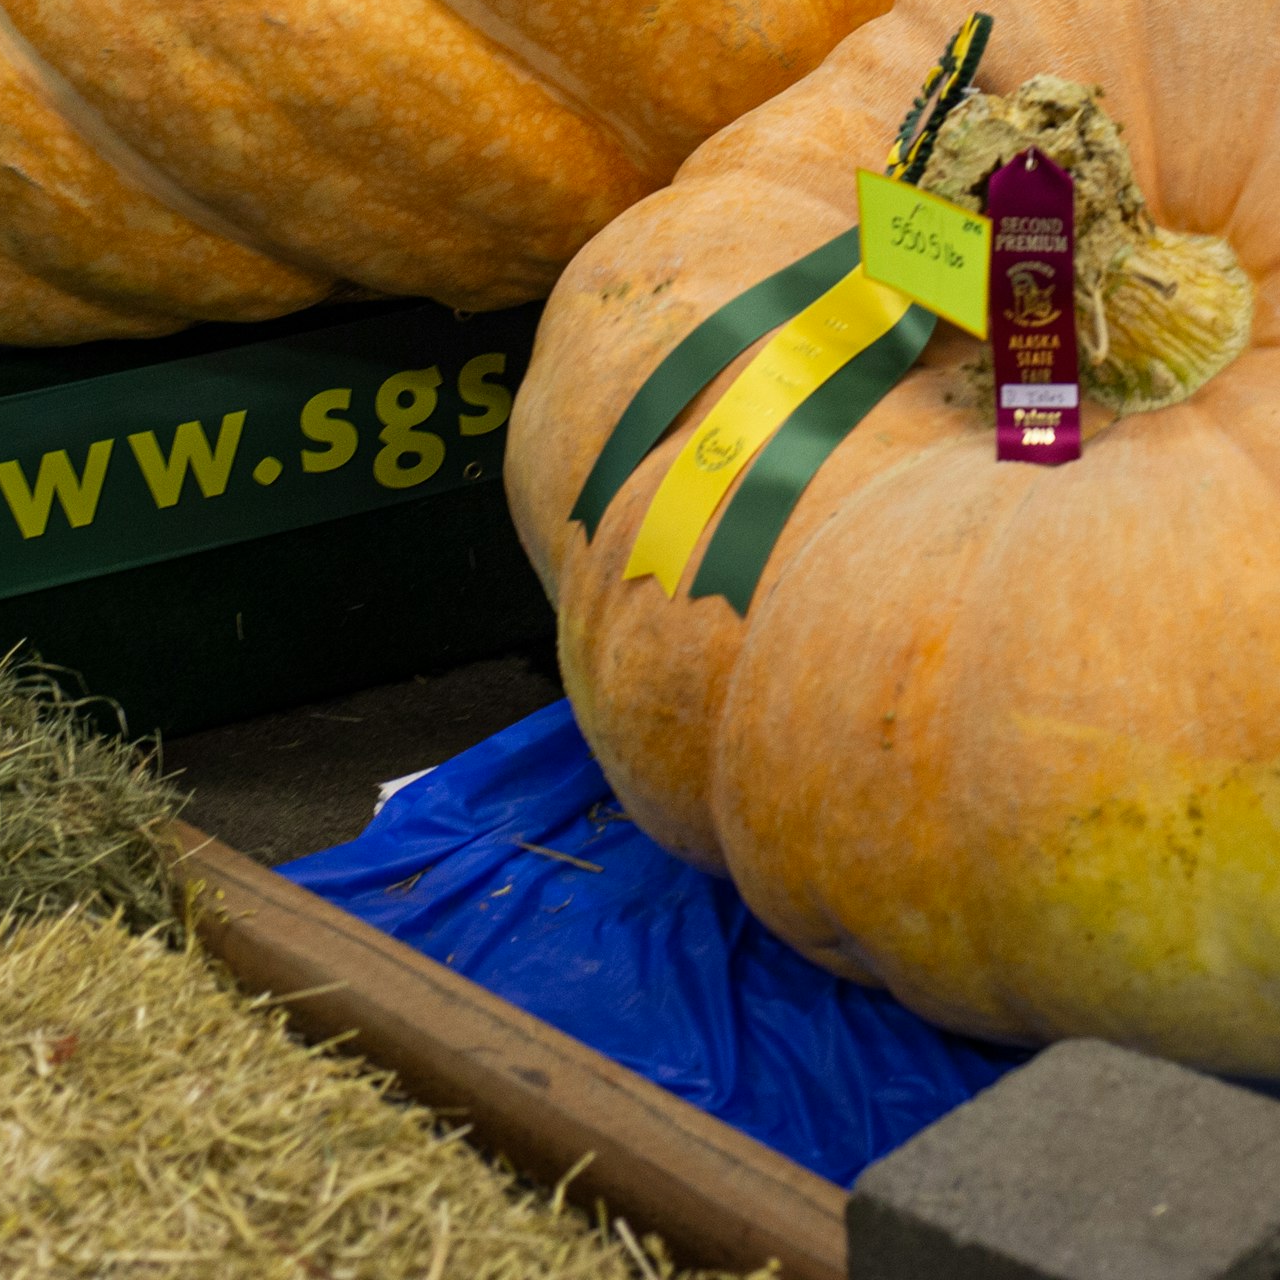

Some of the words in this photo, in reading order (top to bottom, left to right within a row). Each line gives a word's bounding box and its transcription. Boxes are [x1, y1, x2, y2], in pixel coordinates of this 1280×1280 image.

[1001, 216, 1064, 234] SECOND
[995, 233, 1069, 253] PREMIUM
[1008, 334, 1060, 350] ALASKA
[1016, 350, 1054, 368] STATE
[1021, 368, 1051, 384] FAIR
